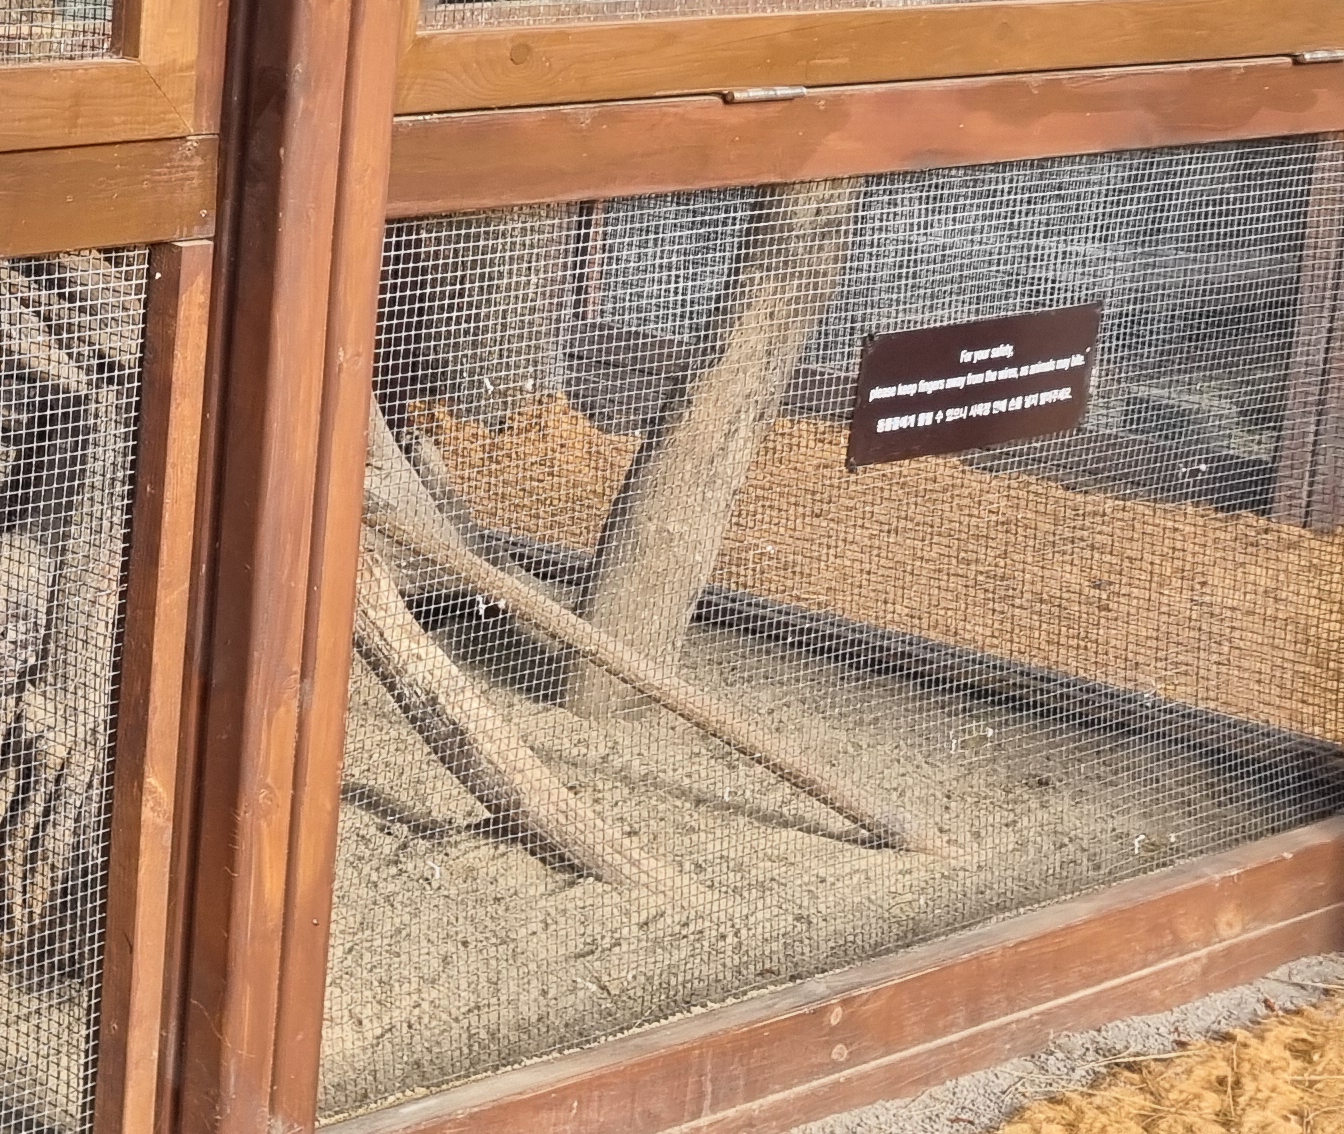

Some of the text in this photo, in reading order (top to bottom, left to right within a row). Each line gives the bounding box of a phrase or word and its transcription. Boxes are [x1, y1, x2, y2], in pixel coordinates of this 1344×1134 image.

[960, 350, 973, 363] For
[973, 349, 991, 363] your
[869, 386, 896, 402] please
[897, 383, 917, 396] keep
[918, 379, 945, 394] fingers
[945, 377, 966, 389] away
[966, 373, 984, 385] from
[985, 370, 997, 382] the
[1029, 360, 1056, 375] animals
[1056, 358, 1071, 370] may
[935, 410, 943, 423] 수
[946, 406, 968, 421] 있으니
